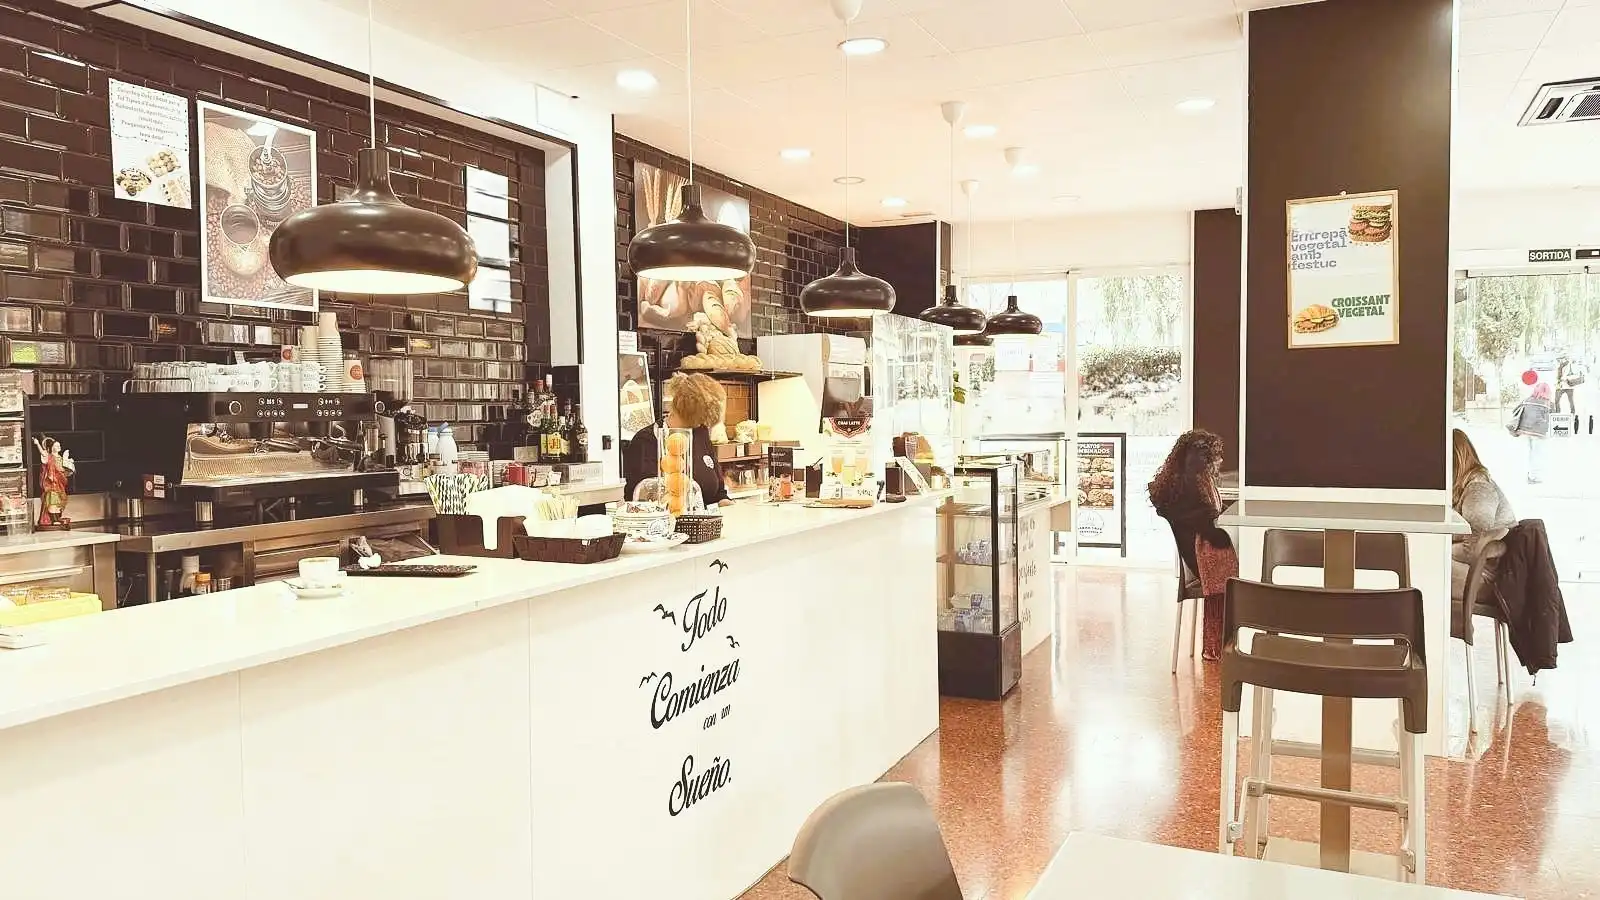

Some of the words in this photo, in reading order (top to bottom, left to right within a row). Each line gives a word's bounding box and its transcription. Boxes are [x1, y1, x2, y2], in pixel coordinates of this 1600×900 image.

[1290, 237, 1348, 252] vegetal
[1290, 249, 1322, 261] amb
[1529, 250, 1570, 260] SORTIDA
[1290, 259, 1337, 271] festuc
[1331, 294, 1391, 308] CROISSANT
[1337, 306, 1385, 318] VEGETAL
[681, 585, 727, 652] Todo
[650, 658, 740, 729] Comienza
[703, 713, 717, 730] con
[721, 704, 731, 719] un
[668, 754, 732, 817] Sueño.
